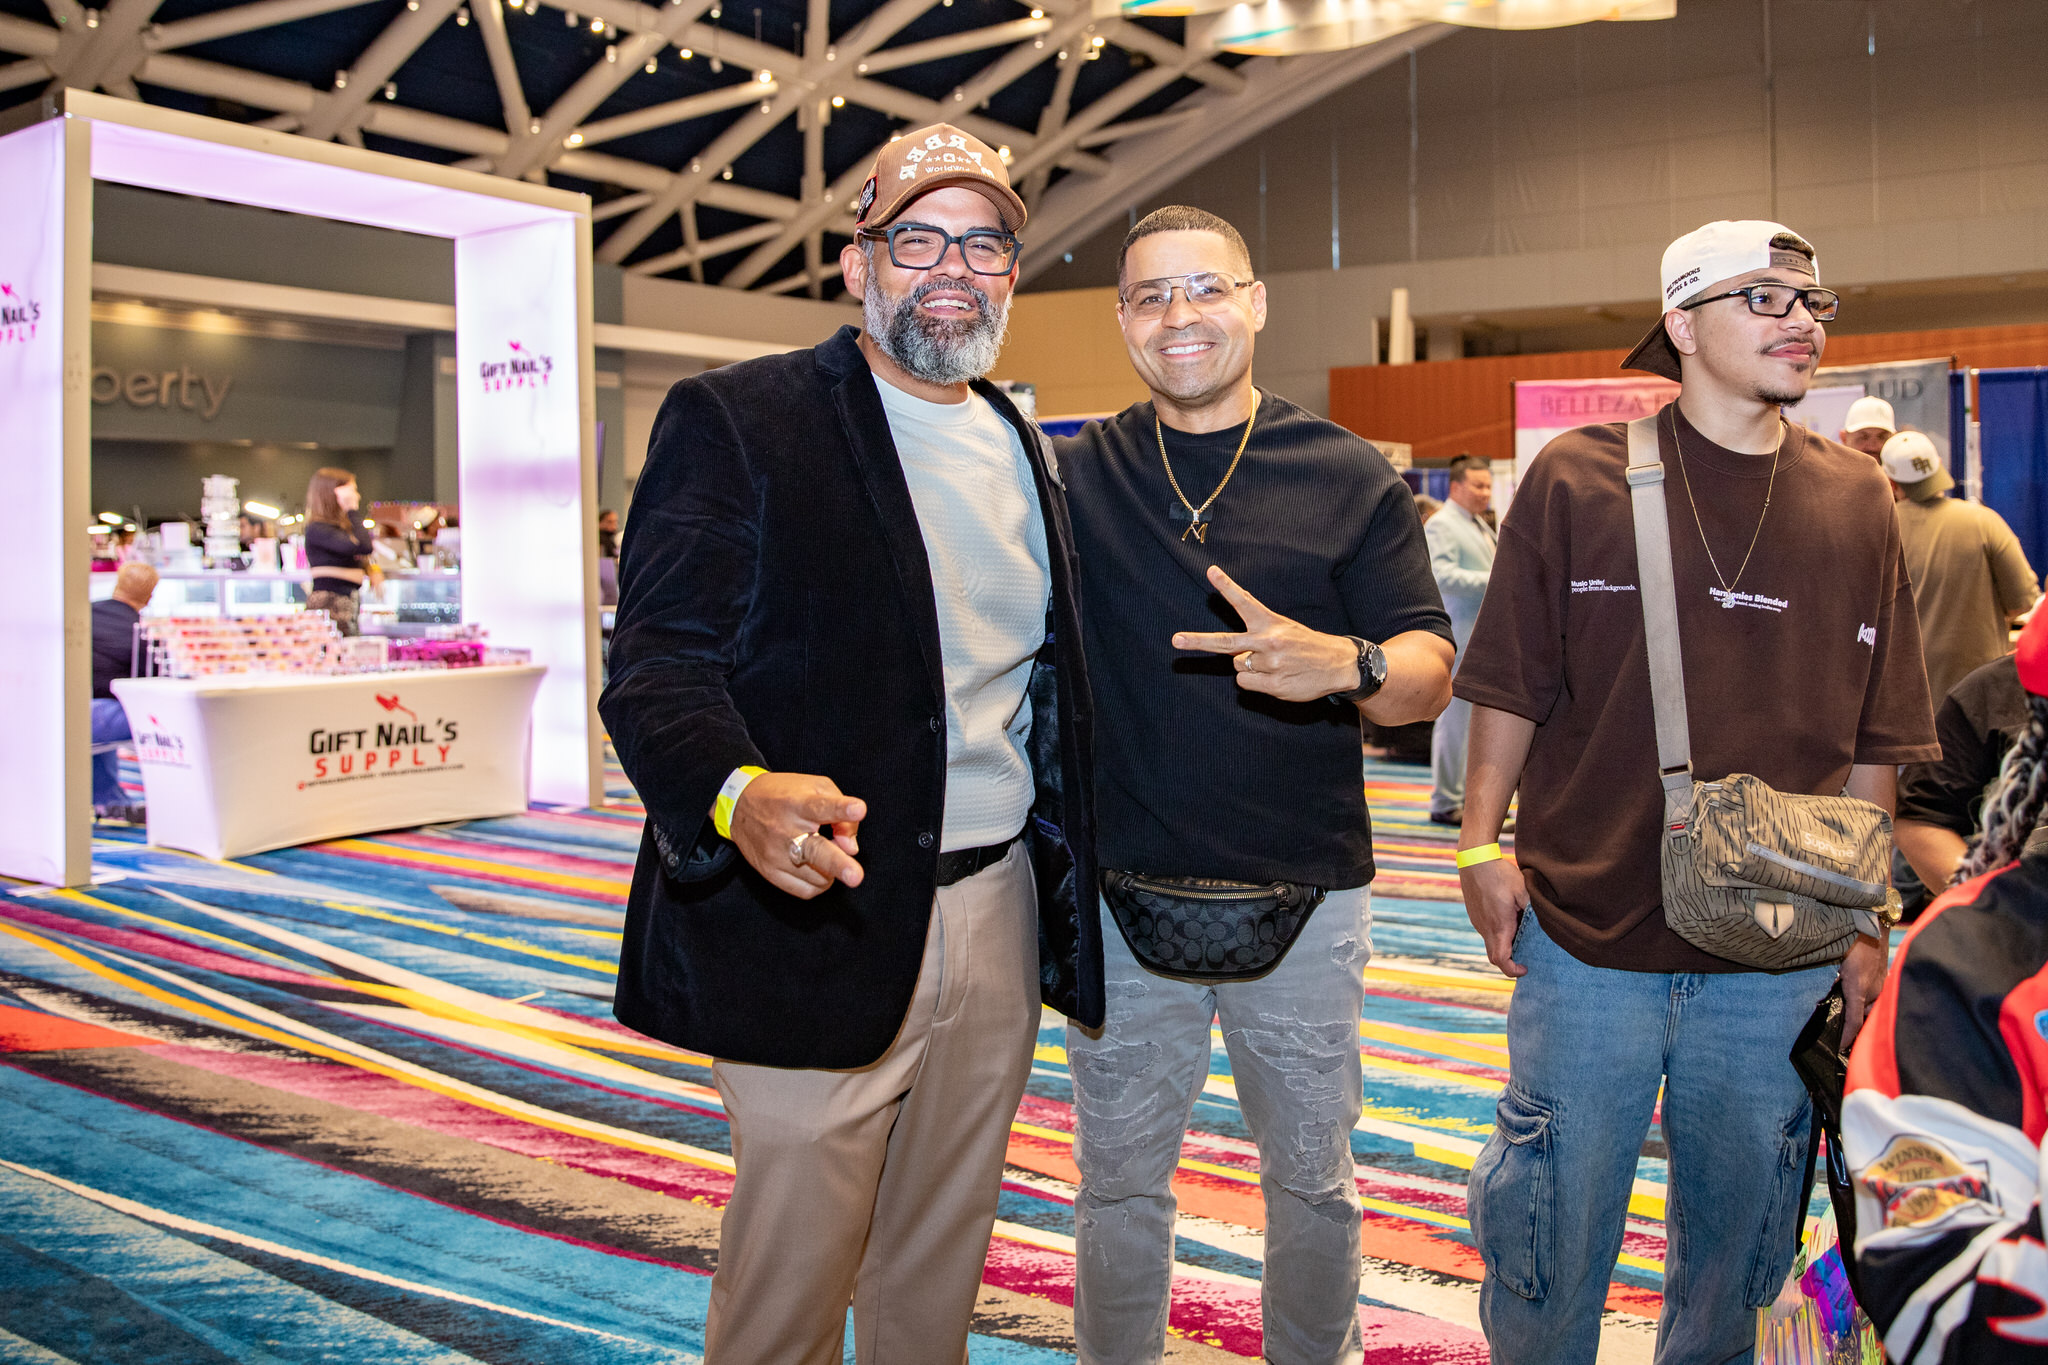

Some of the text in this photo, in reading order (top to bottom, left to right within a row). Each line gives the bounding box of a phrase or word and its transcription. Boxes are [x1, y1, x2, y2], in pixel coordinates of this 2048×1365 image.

[925, 165, 970, 174] WorldWi
[1541, 391, 1646, 417] BELLEZA
[1570, 580, 1588, 588] Music
[1571, 586, 1588, 594] people
[1754, 594, 1789, 608] Blended
[310, 728, 367, 755] GIFT
[315, 745, 450, 779] SUPPLY
[1804, 832, 1854, 858] Supreme
[1879, 1145, 1944, 1171] WINNER
[1898, 1166, 1934, 1183] TIME
